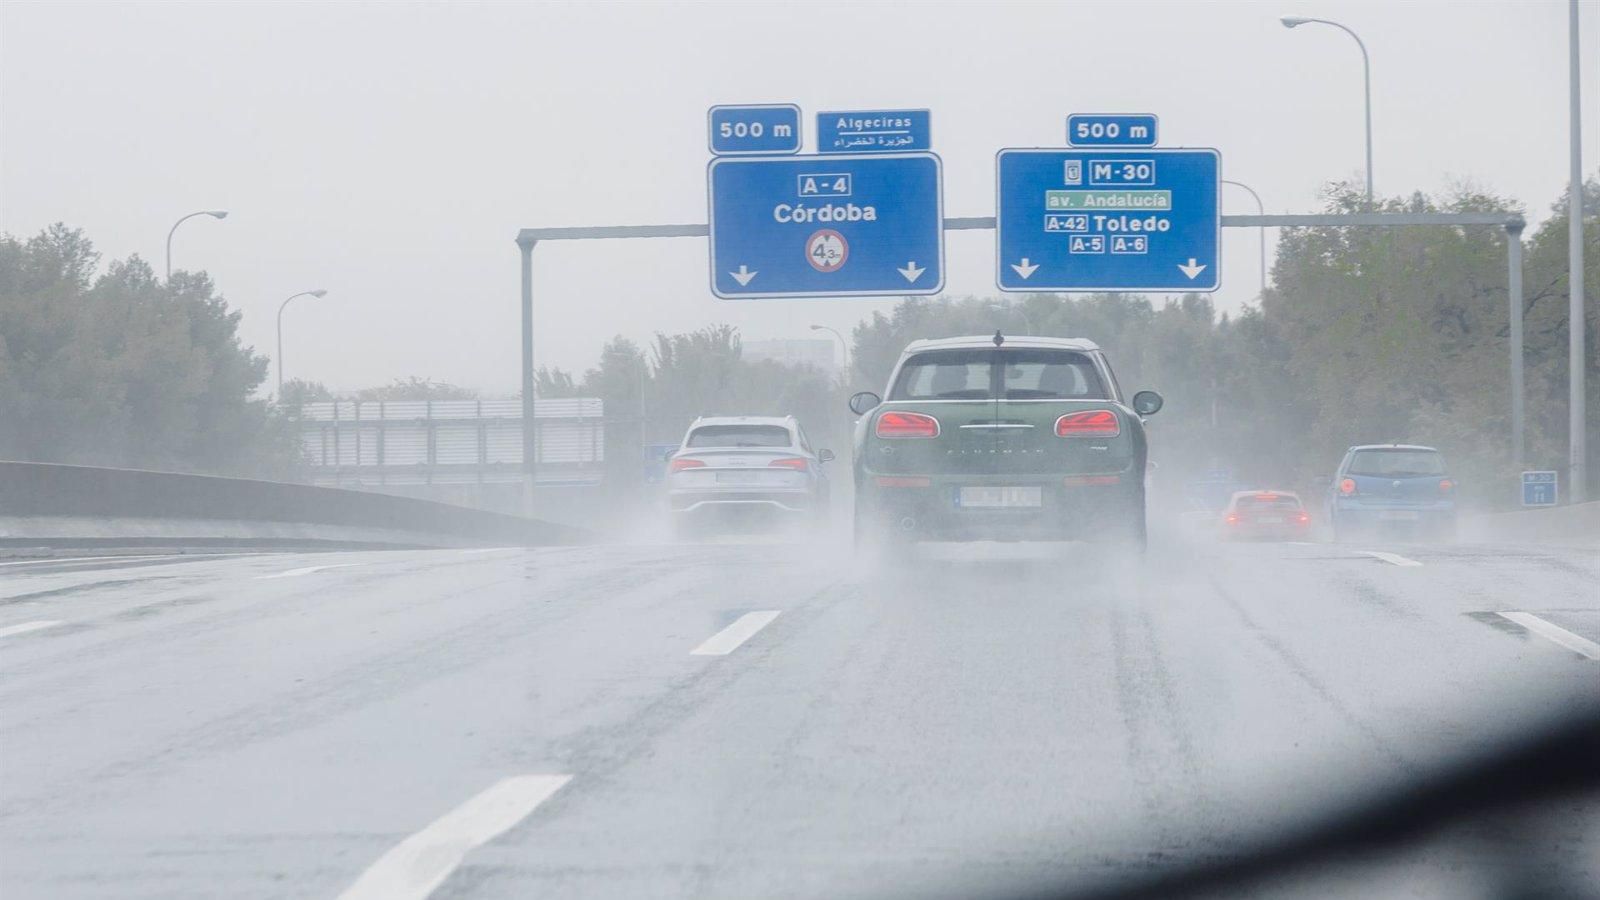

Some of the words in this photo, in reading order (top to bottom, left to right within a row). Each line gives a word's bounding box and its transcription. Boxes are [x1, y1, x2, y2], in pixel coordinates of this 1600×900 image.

[721, 123, 763, 137] 500
[774, 125, 790, 136] m
[837, 118, 911, 131] Algeciras
[1078, 123, 1119, 137] 500
[1130, 126, 1147, 137] m
[1095, 165, 1149, 180] M-30
[803, 178, 846, 193] A-4
[1050, 197, 1073, 206] av.
[1084, 194, 1167, 206] Andalucía
[774, 204, 876, 222] Córdoba
[1047, 217, 1085, 229] A-42
[1094, 216, 1169, 231] Toledo
[1072, 238, 1101, 250] A-5
[1115, 238, 1144, 250] A-6
